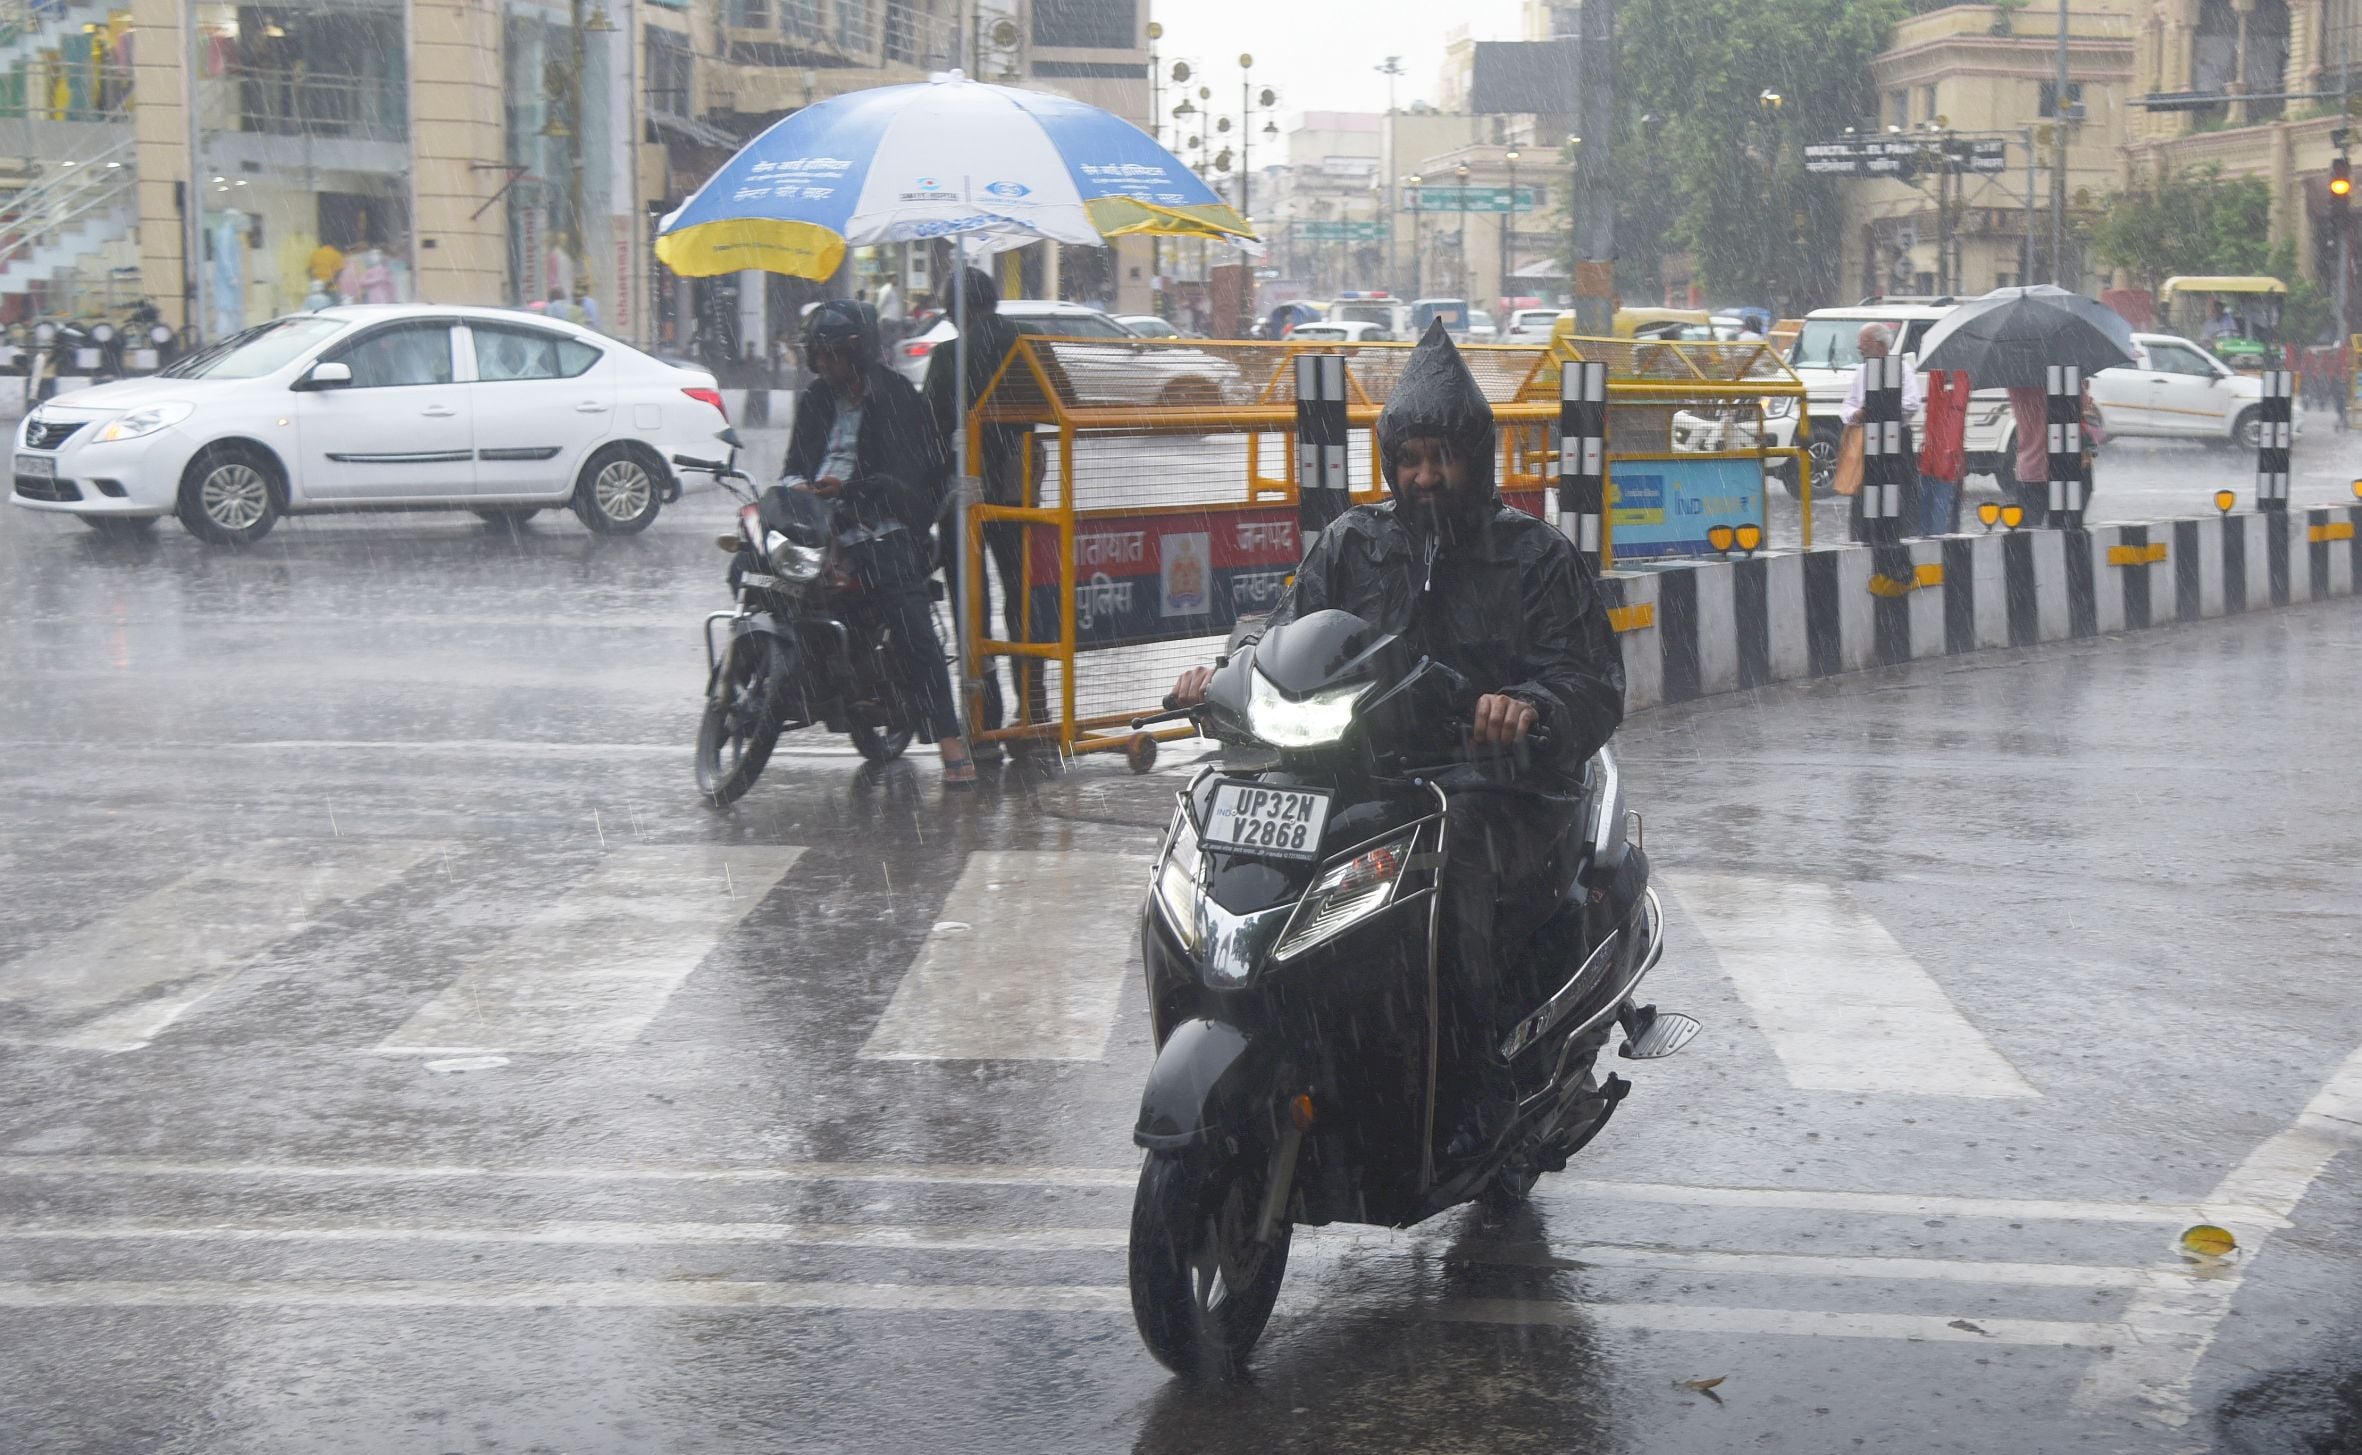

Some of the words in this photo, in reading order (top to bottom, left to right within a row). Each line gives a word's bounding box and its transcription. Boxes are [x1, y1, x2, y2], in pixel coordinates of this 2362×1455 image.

[1073, 531, 1146, 566] ातायात
[1233, 570, 1290, 602] लखन
[1237, 789, 1315, 822] UP32N
[1232, 817, 1307, 848] V2868
